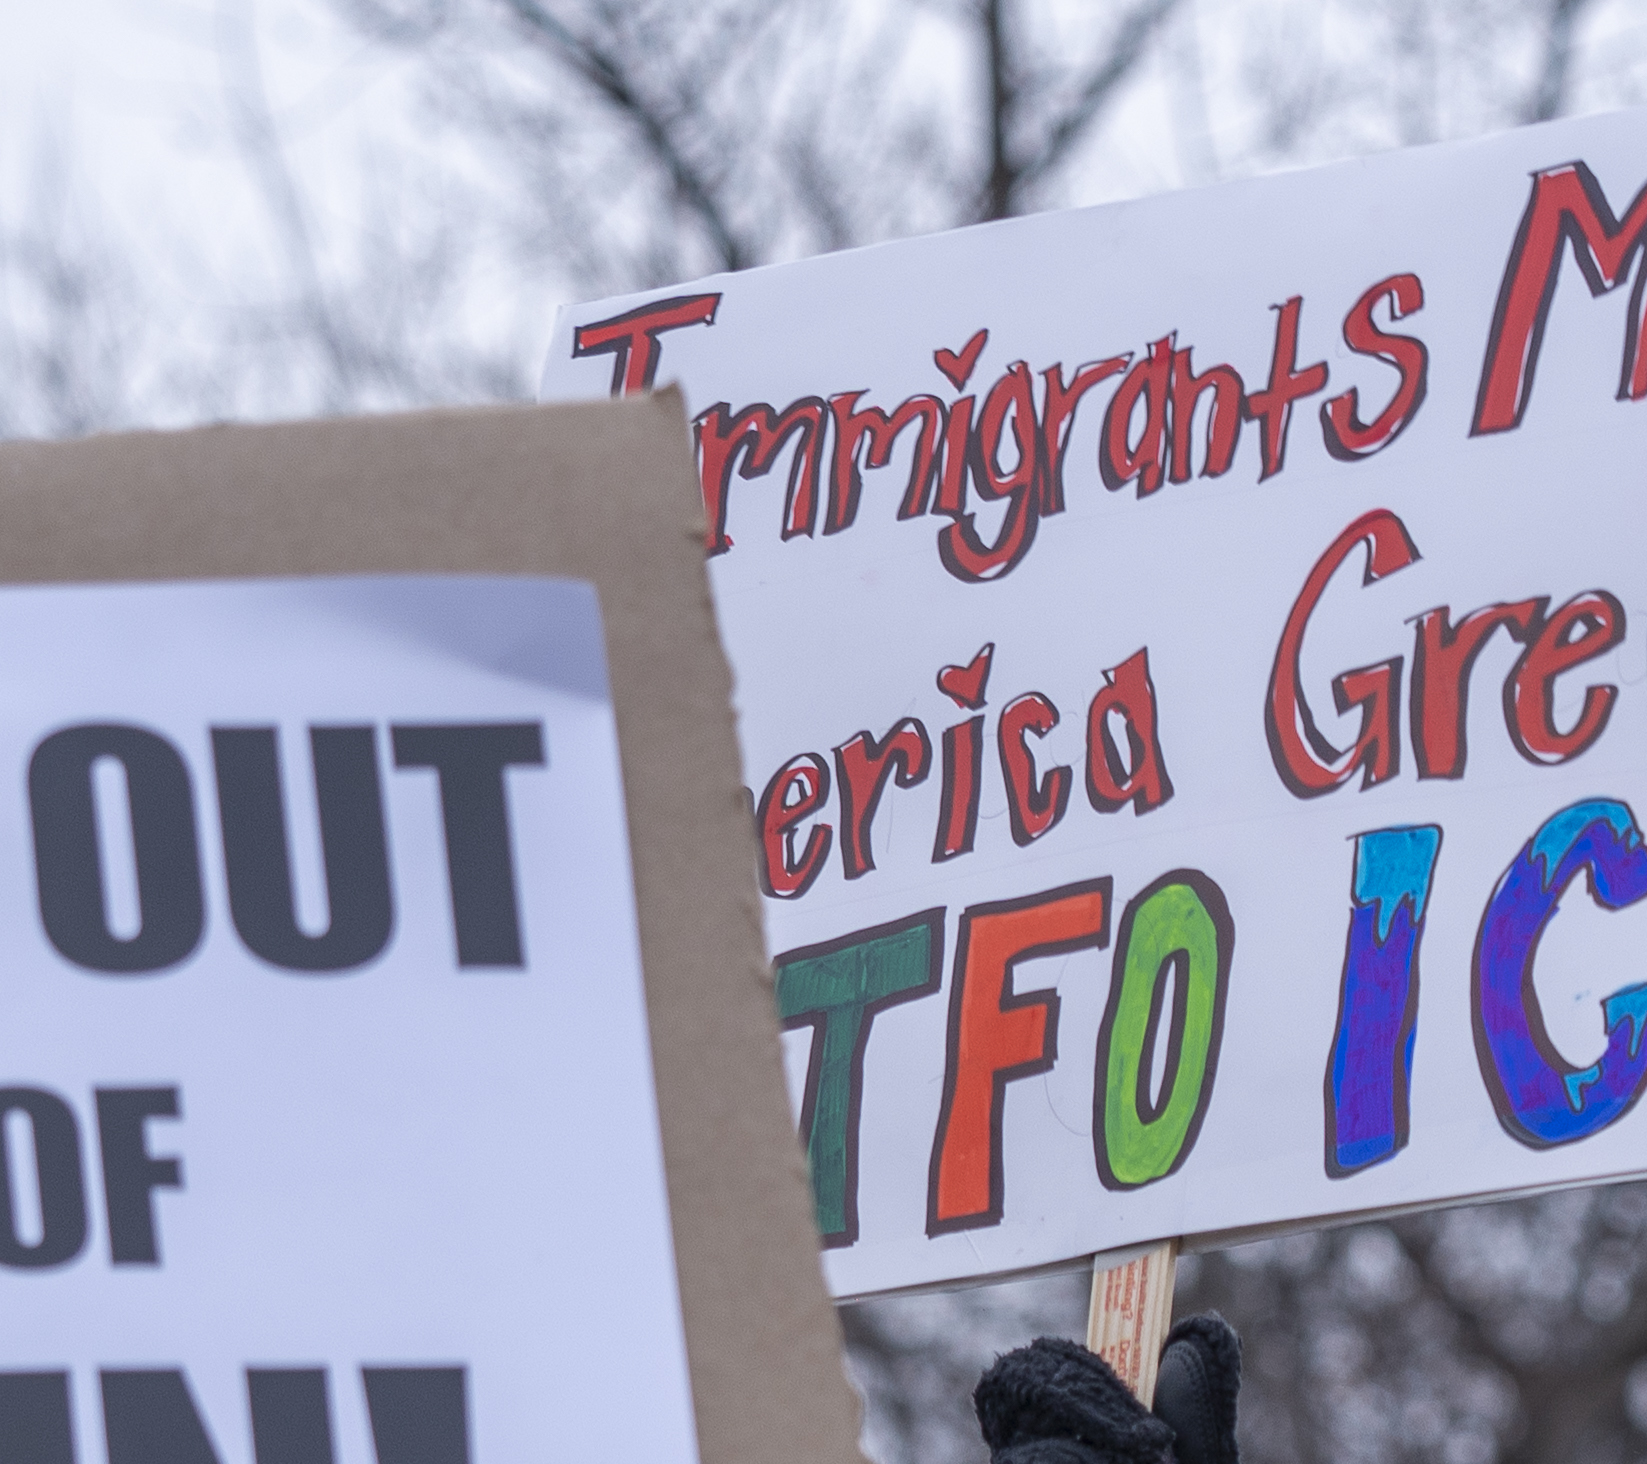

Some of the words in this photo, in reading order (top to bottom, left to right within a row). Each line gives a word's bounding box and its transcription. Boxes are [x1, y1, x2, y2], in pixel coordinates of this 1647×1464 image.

[27, 719, 547, 975] OUT
[752, 644, 1166, 899] erica
[774, 867, 1236, 1250] TFO
